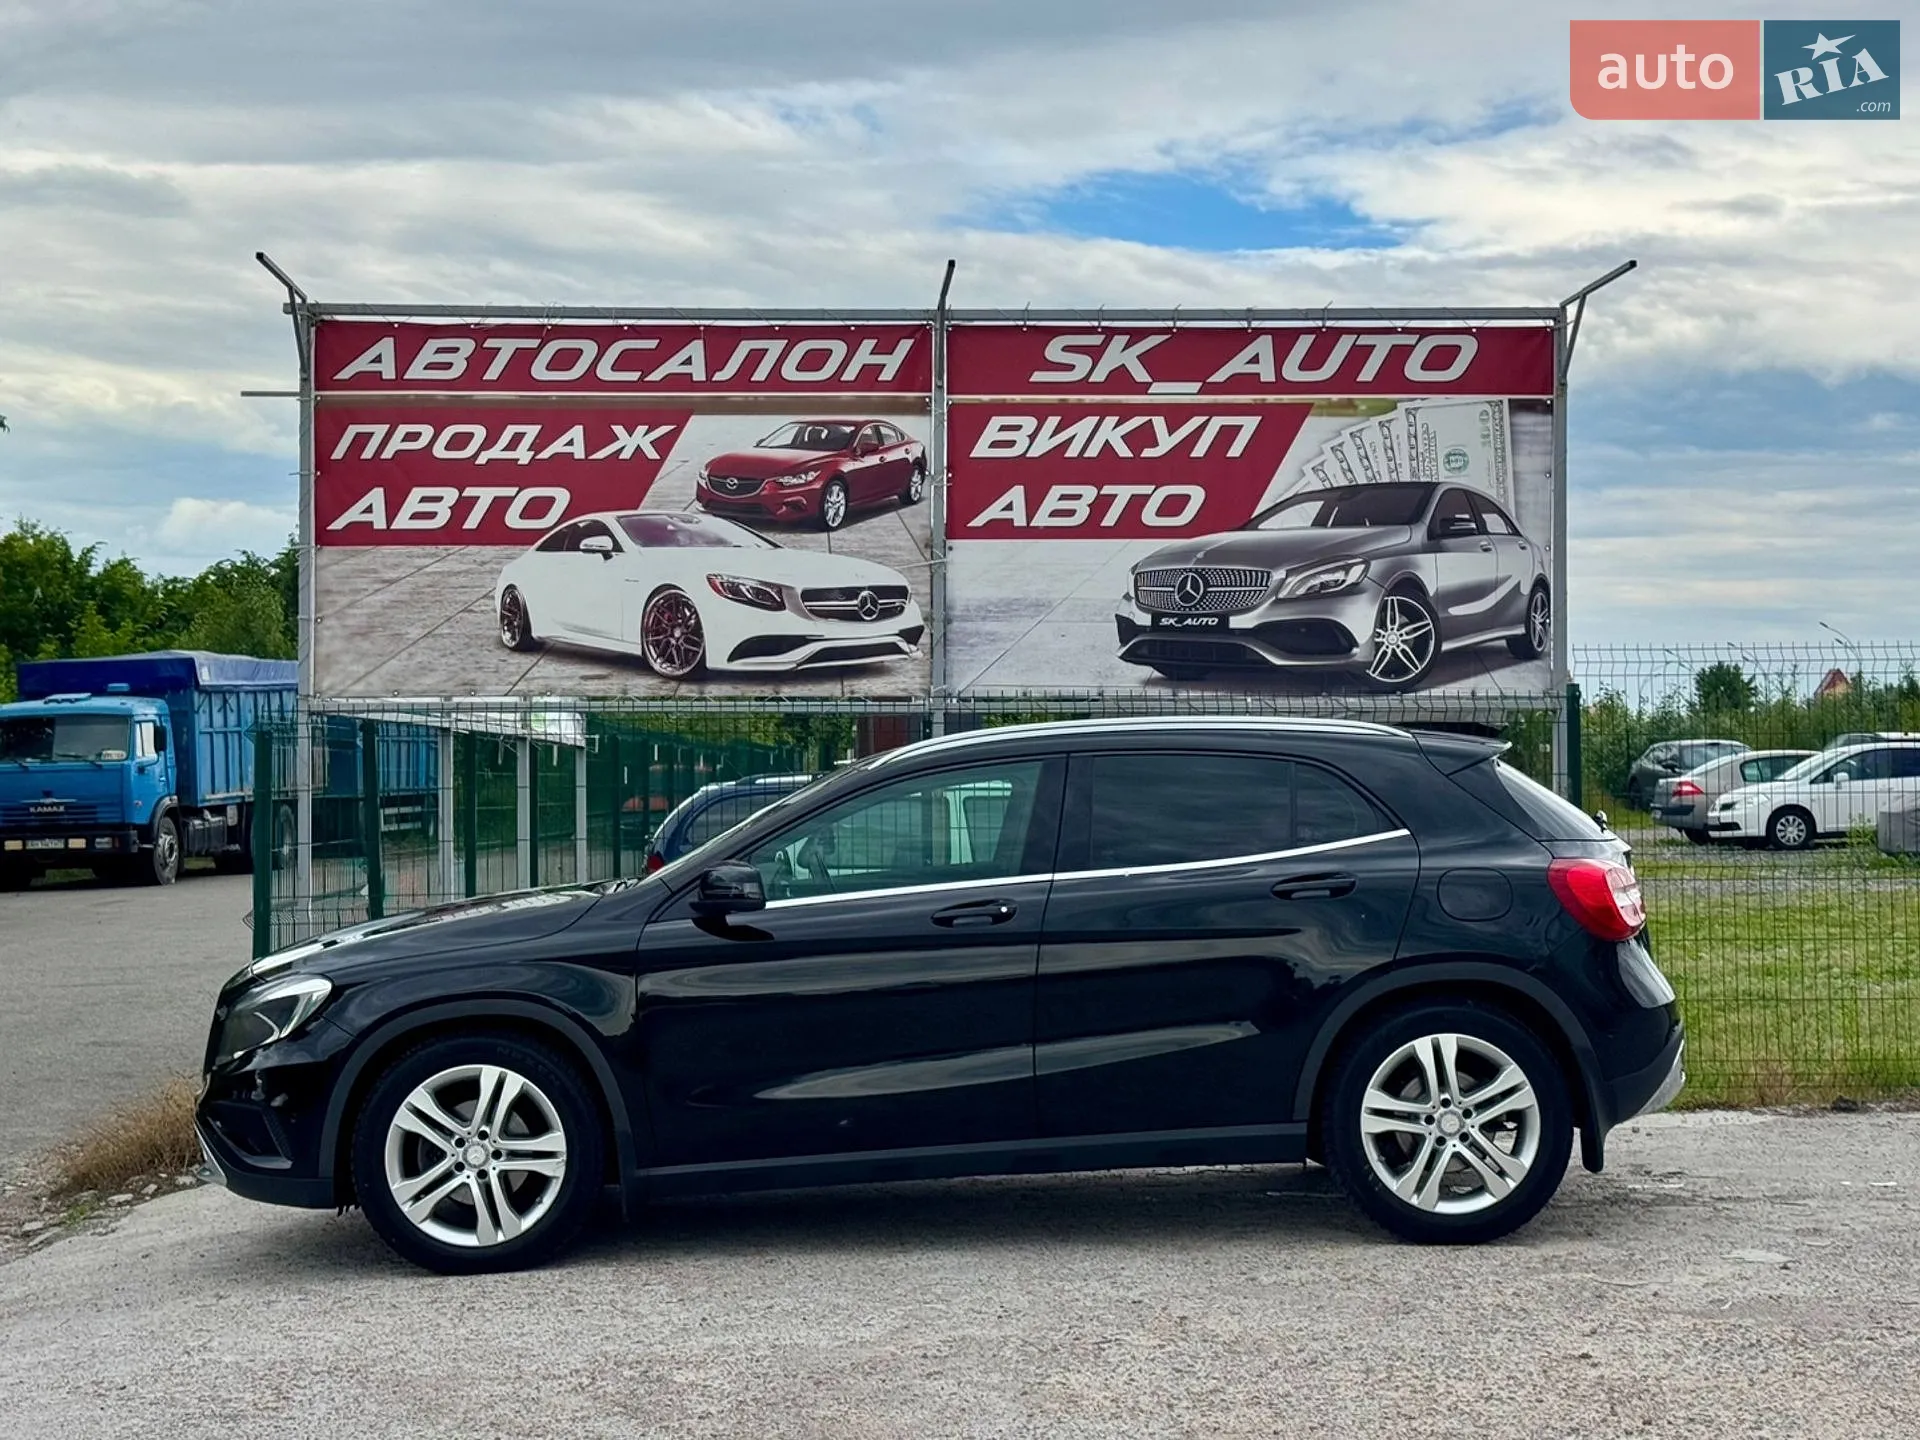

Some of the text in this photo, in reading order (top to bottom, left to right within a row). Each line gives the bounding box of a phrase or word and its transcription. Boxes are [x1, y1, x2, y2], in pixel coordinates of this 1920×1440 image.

[333, 337, 914, 381] АВТОСАЛОН
[1029, 334, 1478, 394] SK_AUTO
[330, 424, 676, 465] ПРОДАЖ
[970, 416, 1262, 458] ВИКУП
[327, 487, 571, 530] АВТО
[967, 485, 1206, 527] АВТО
[1159, 617, 1219, 627] SK_AUTO
